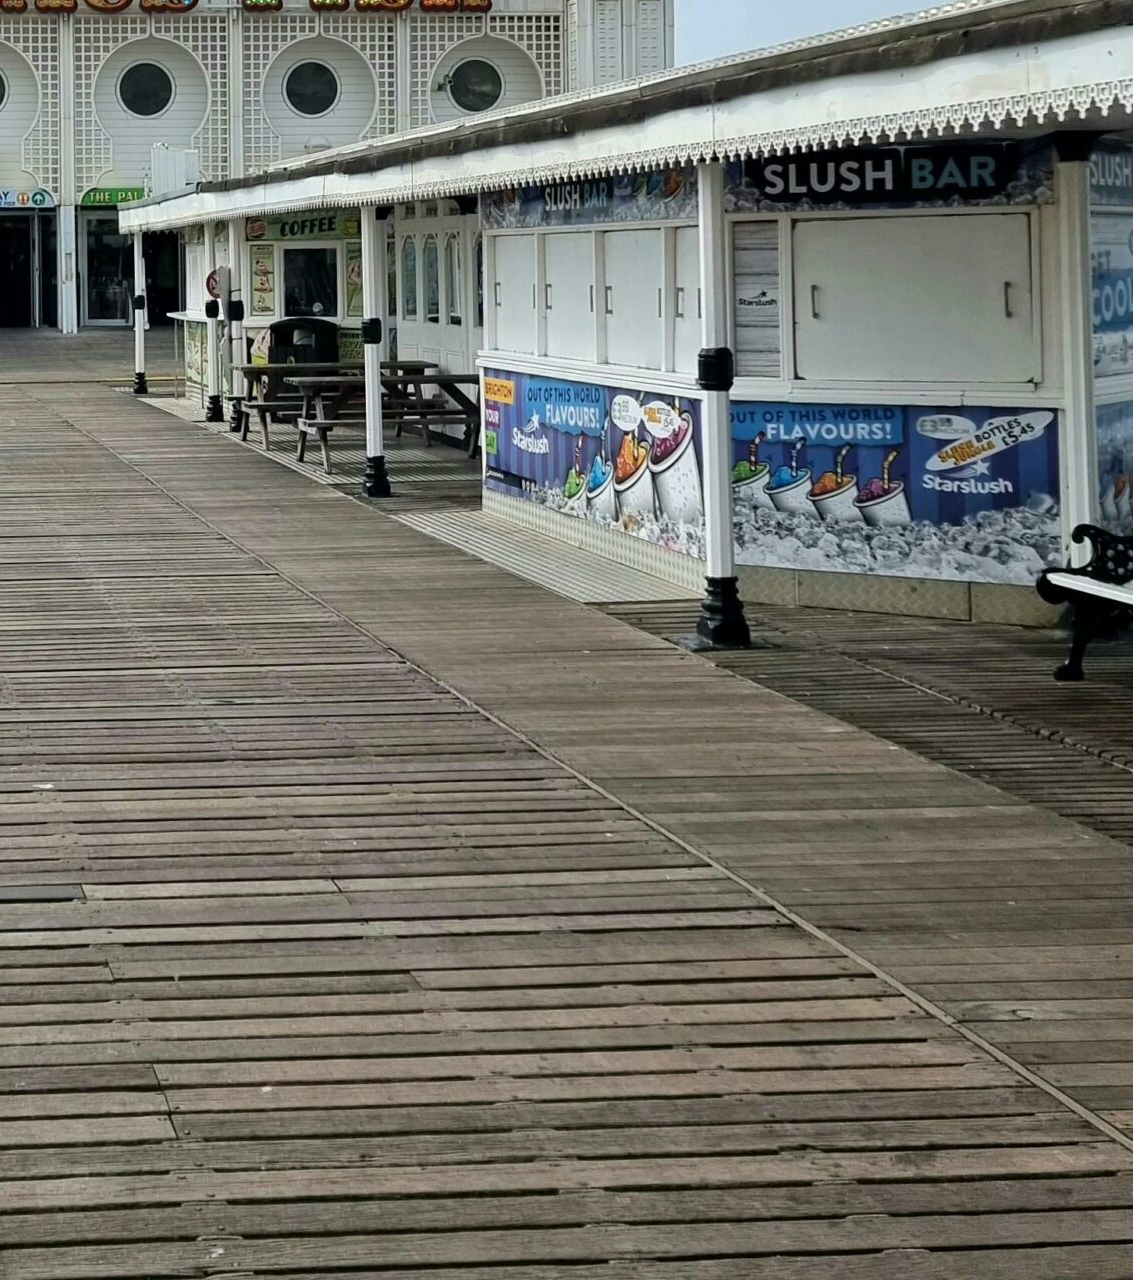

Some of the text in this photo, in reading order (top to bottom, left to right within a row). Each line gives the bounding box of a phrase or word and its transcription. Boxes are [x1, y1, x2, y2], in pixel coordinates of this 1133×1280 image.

[764, 156, 996, 195] SLUSH BAR
[89, 192, 110, 202] THE
[545, 182, 607, 211] SLUSH BAR
[280, 217, 336, 236] COFFEE
[738, 297, 777, 306] Starslush
[528, 388, 600, 403] OUT OF THIS WORLD
[546, 404, 600, 428] FLAVOURS!
[762, 411, 783, 422] OF
[787, 410, 826, 421] THIS
[829, 408, 894, 420] WORLD
[767, 423, 891, 440] FLAVOURS!
[974, 418, 1022, 443] BOTTLES
[1002, 424, 1035, 447] £5.45
[512, 430, 549, 454] Starslush
[922, 474, 1013, 494] Starslush
